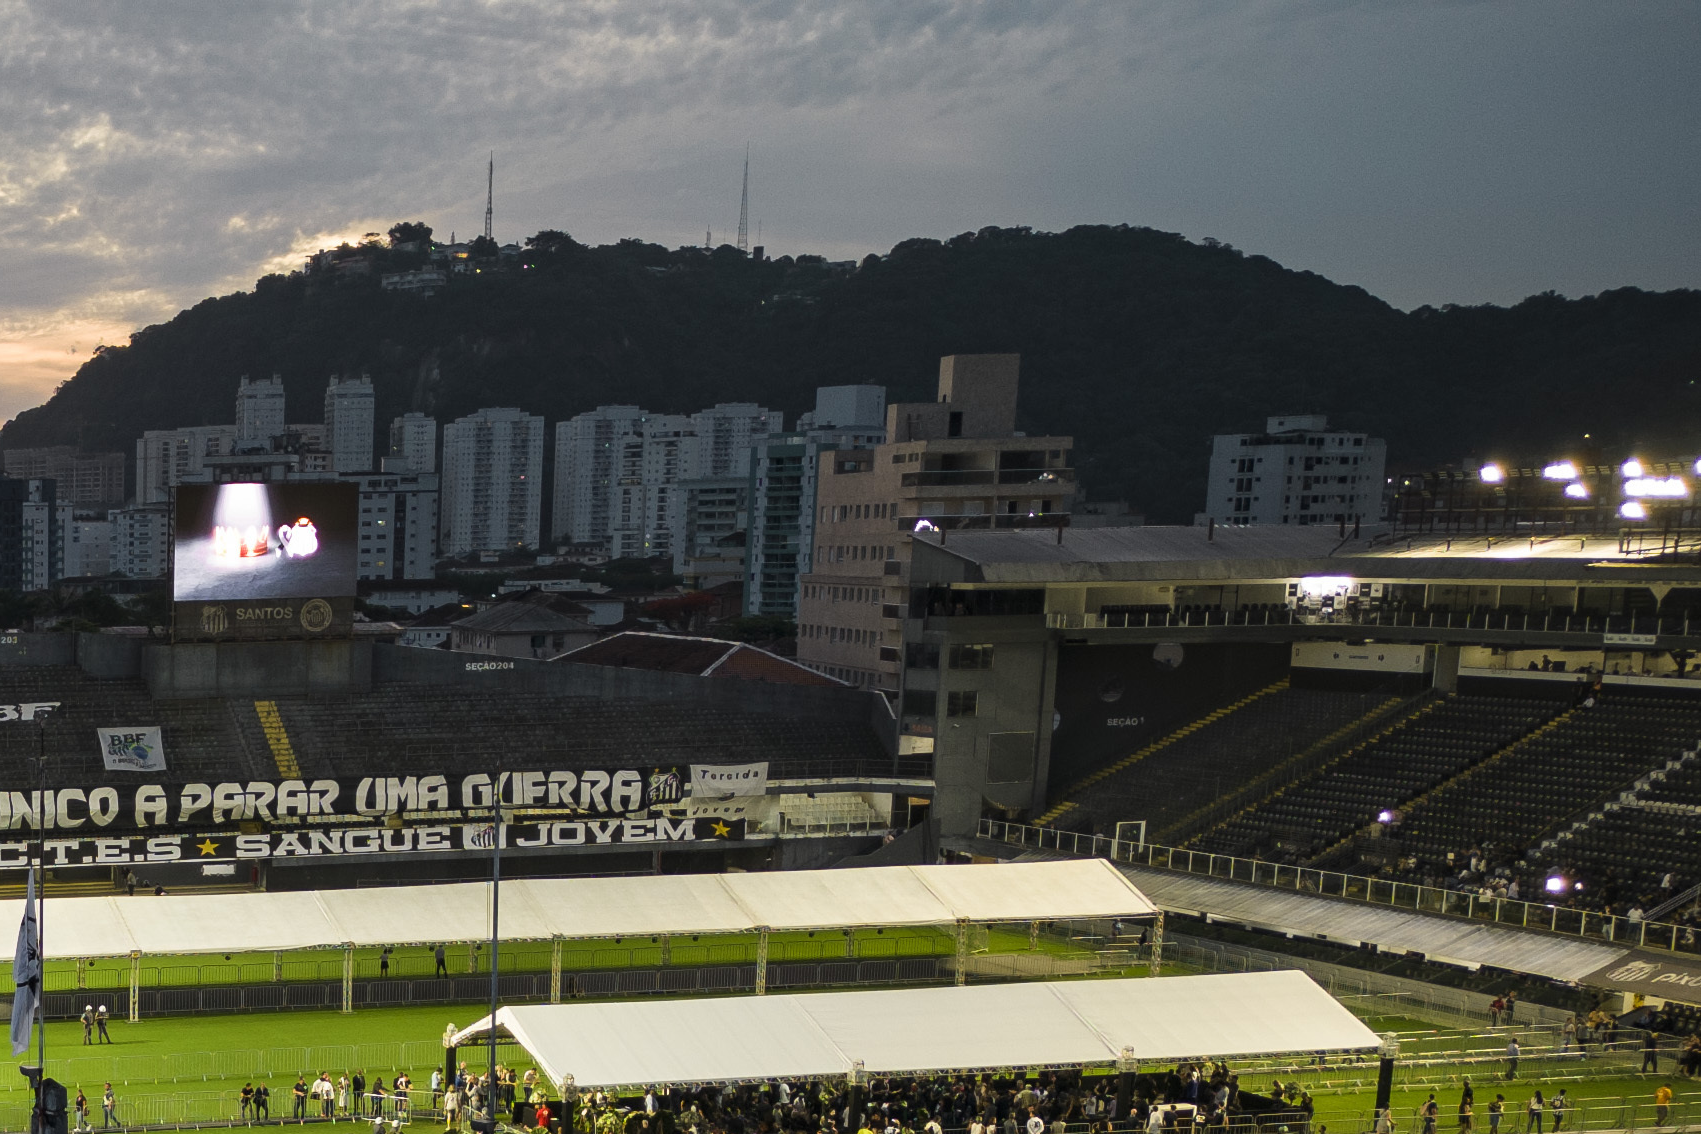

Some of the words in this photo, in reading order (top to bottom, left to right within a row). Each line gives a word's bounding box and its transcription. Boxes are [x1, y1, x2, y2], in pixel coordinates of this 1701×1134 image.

[236, 607, 293, 620] SANTOS
[135, 784, 168, 827] A
[178, 779, 340, 822] PARAR
[356, 775, 449, 817] UMA
[461, 770, 642, 814] GUERRA
[236, 827, 451, 858] SANGUE
[516, 818, 696, 847] JOVEM
